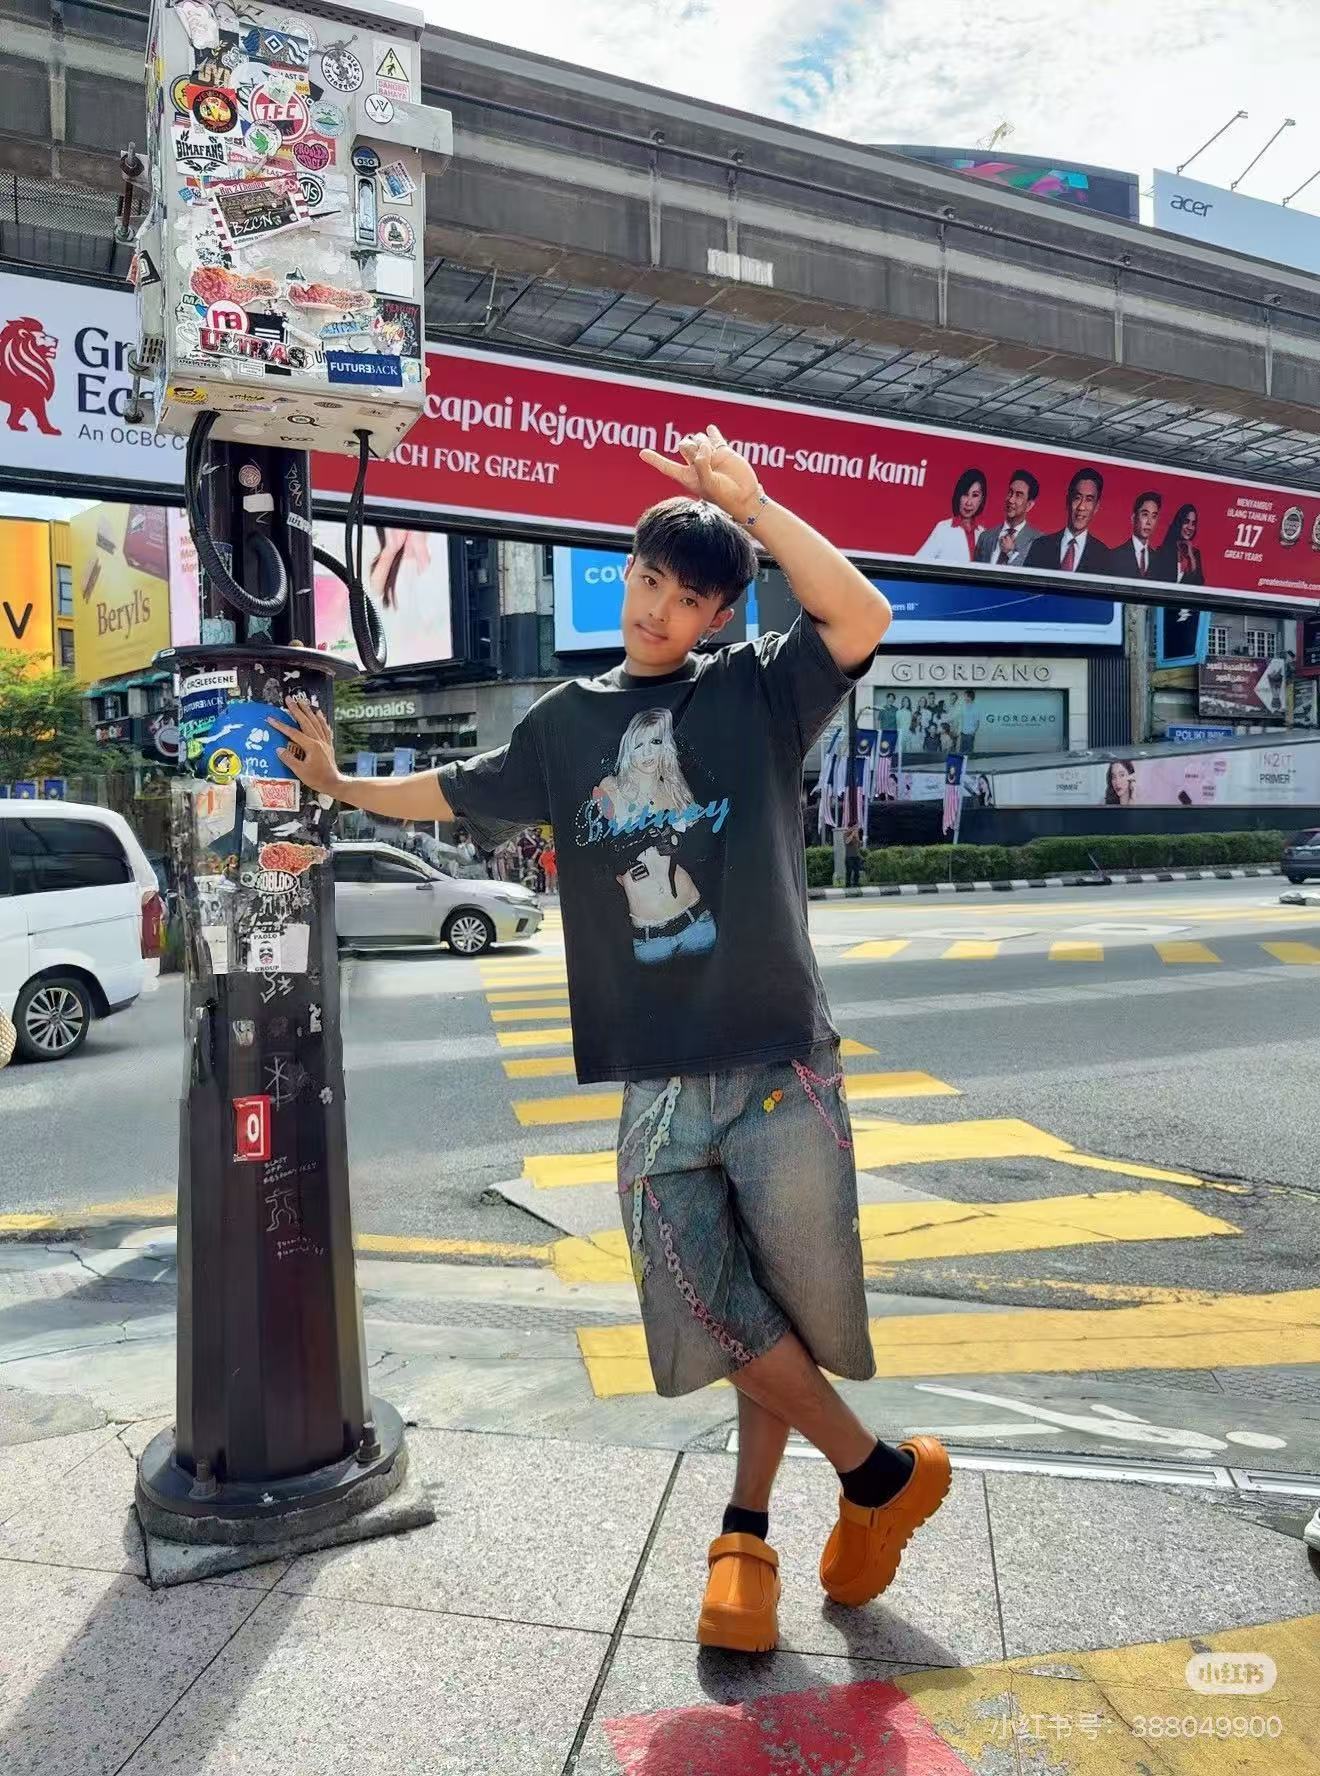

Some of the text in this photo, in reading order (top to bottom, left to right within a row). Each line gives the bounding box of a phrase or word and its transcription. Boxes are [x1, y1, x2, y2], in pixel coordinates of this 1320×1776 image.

[176, 139, 224, 161] BIMAFANS
[1170, 194, 1213, 217] acer
[78, 424, 187, 451] An OCBC C
[423, 394, 515, 432] capai
[520, 400, 658, 451] Kejayaan
[868, 452, 928, 488] kami
[434, 448, 480, 475] FOR
[485, 456, 560, 485] GREAT
[1234, 523, 1264, 548] 117
[1224, 549, 1264, 562] GREAT YEARS
[97, 589, 151, 639] Beryl's
[891, 662, 1053, 684] GIORDANO
[985, 713, 1056, 725] GIORDANO
[1259, 772, 1291, 785] PRIMER
[575, 797, 729, 847] Britney
